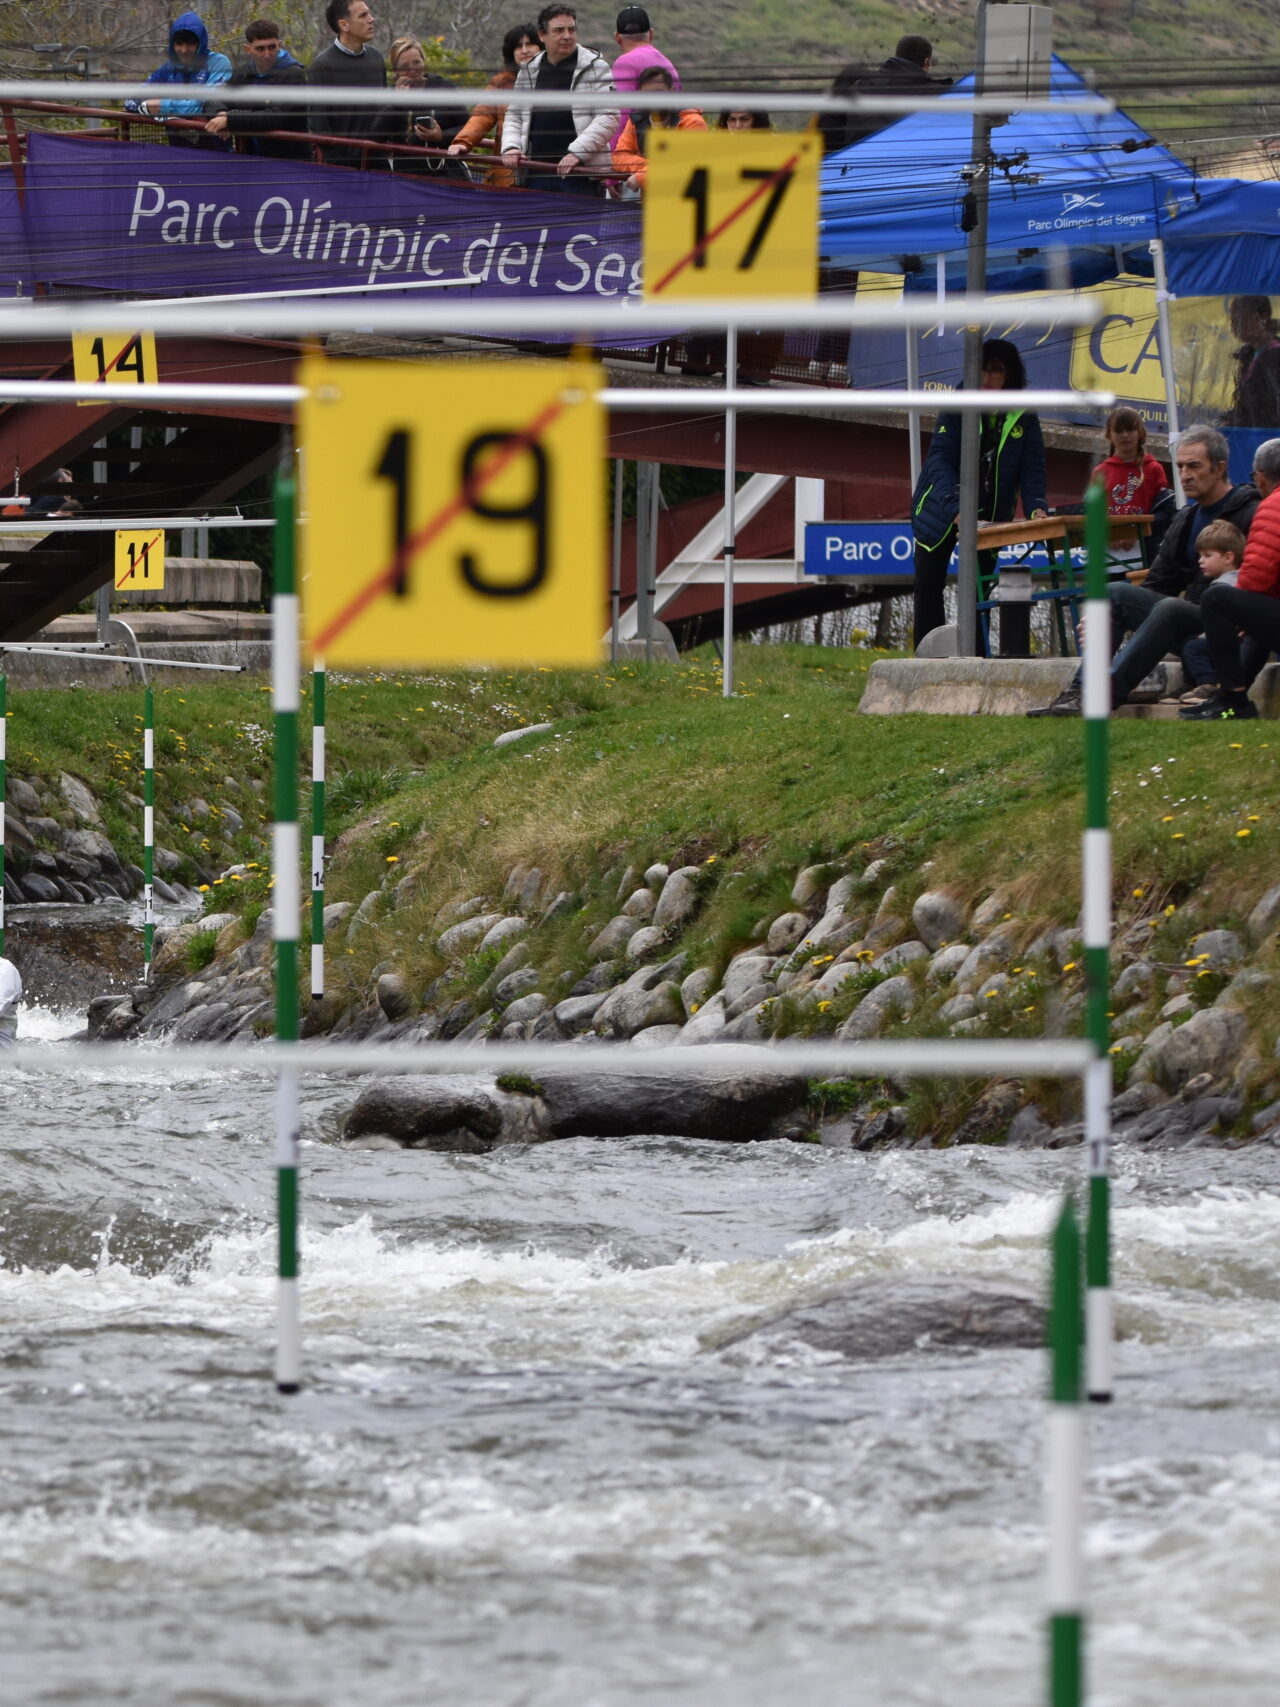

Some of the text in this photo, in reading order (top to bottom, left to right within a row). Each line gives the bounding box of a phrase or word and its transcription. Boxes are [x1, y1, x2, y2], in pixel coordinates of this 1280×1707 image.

[681, 166, 798, 272] 17
[1028, 219, 1051, 231] Parc
[1115, 214, 1146, 227] Segre
[128, 180, 646, 309] Parc Olímpic del Seg
[89, 336, 145, 384] 14
[372, 425, 553, 601] 19
[126, 541, 150, 579] 11
[824, 536, 883, 561] Parc
